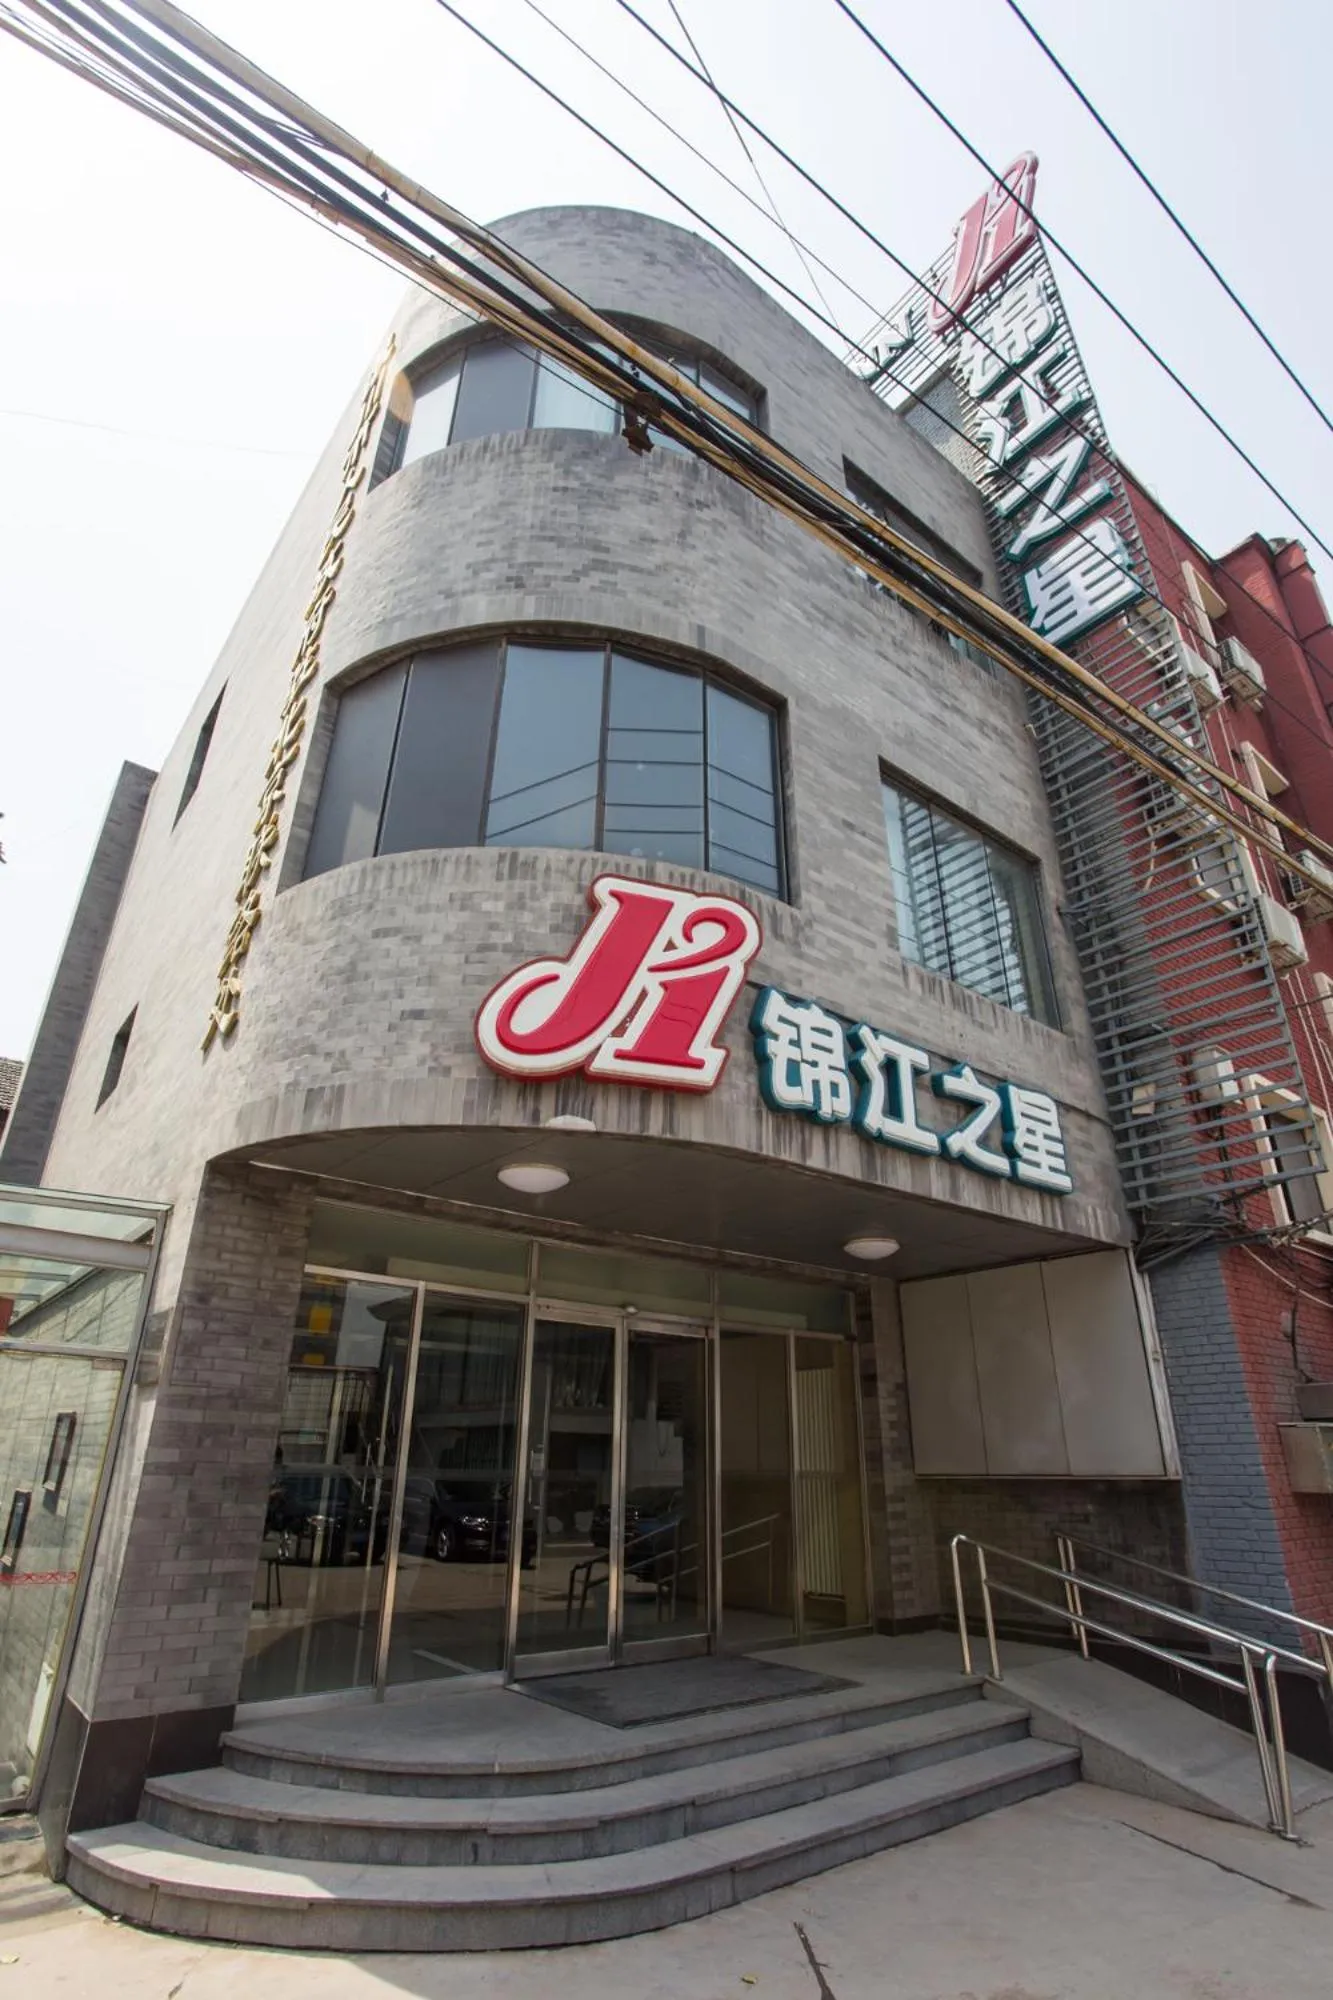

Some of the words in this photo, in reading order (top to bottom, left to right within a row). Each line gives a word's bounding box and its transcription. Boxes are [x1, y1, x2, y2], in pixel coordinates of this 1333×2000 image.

[957, 272, 1144, 648] 锦江之星
[752, 988, 1073, 1194] 锦江之星
